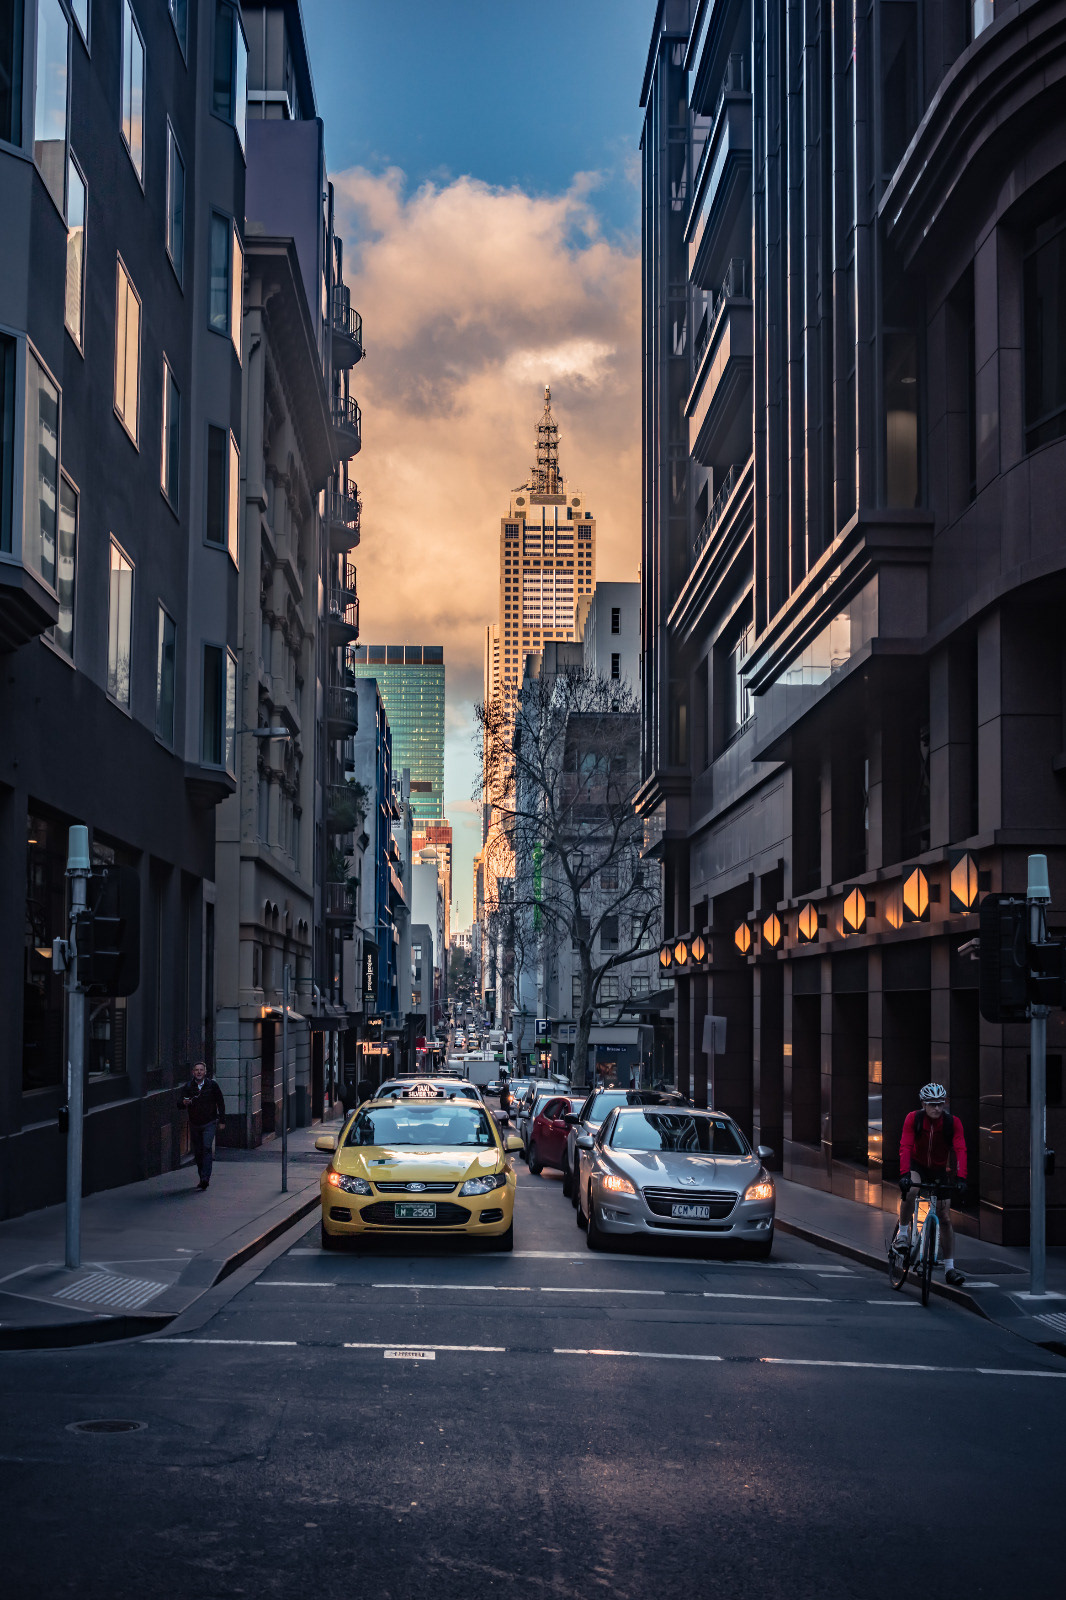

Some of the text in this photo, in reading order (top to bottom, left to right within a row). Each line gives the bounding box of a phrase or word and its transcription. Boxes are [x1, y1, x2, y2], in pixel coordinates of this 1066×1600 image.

[538, 1021, 547, 1033] P
[412, 1209, 434, 1217] 2565
[672, 1205, 709, 1216] ZCM 170
